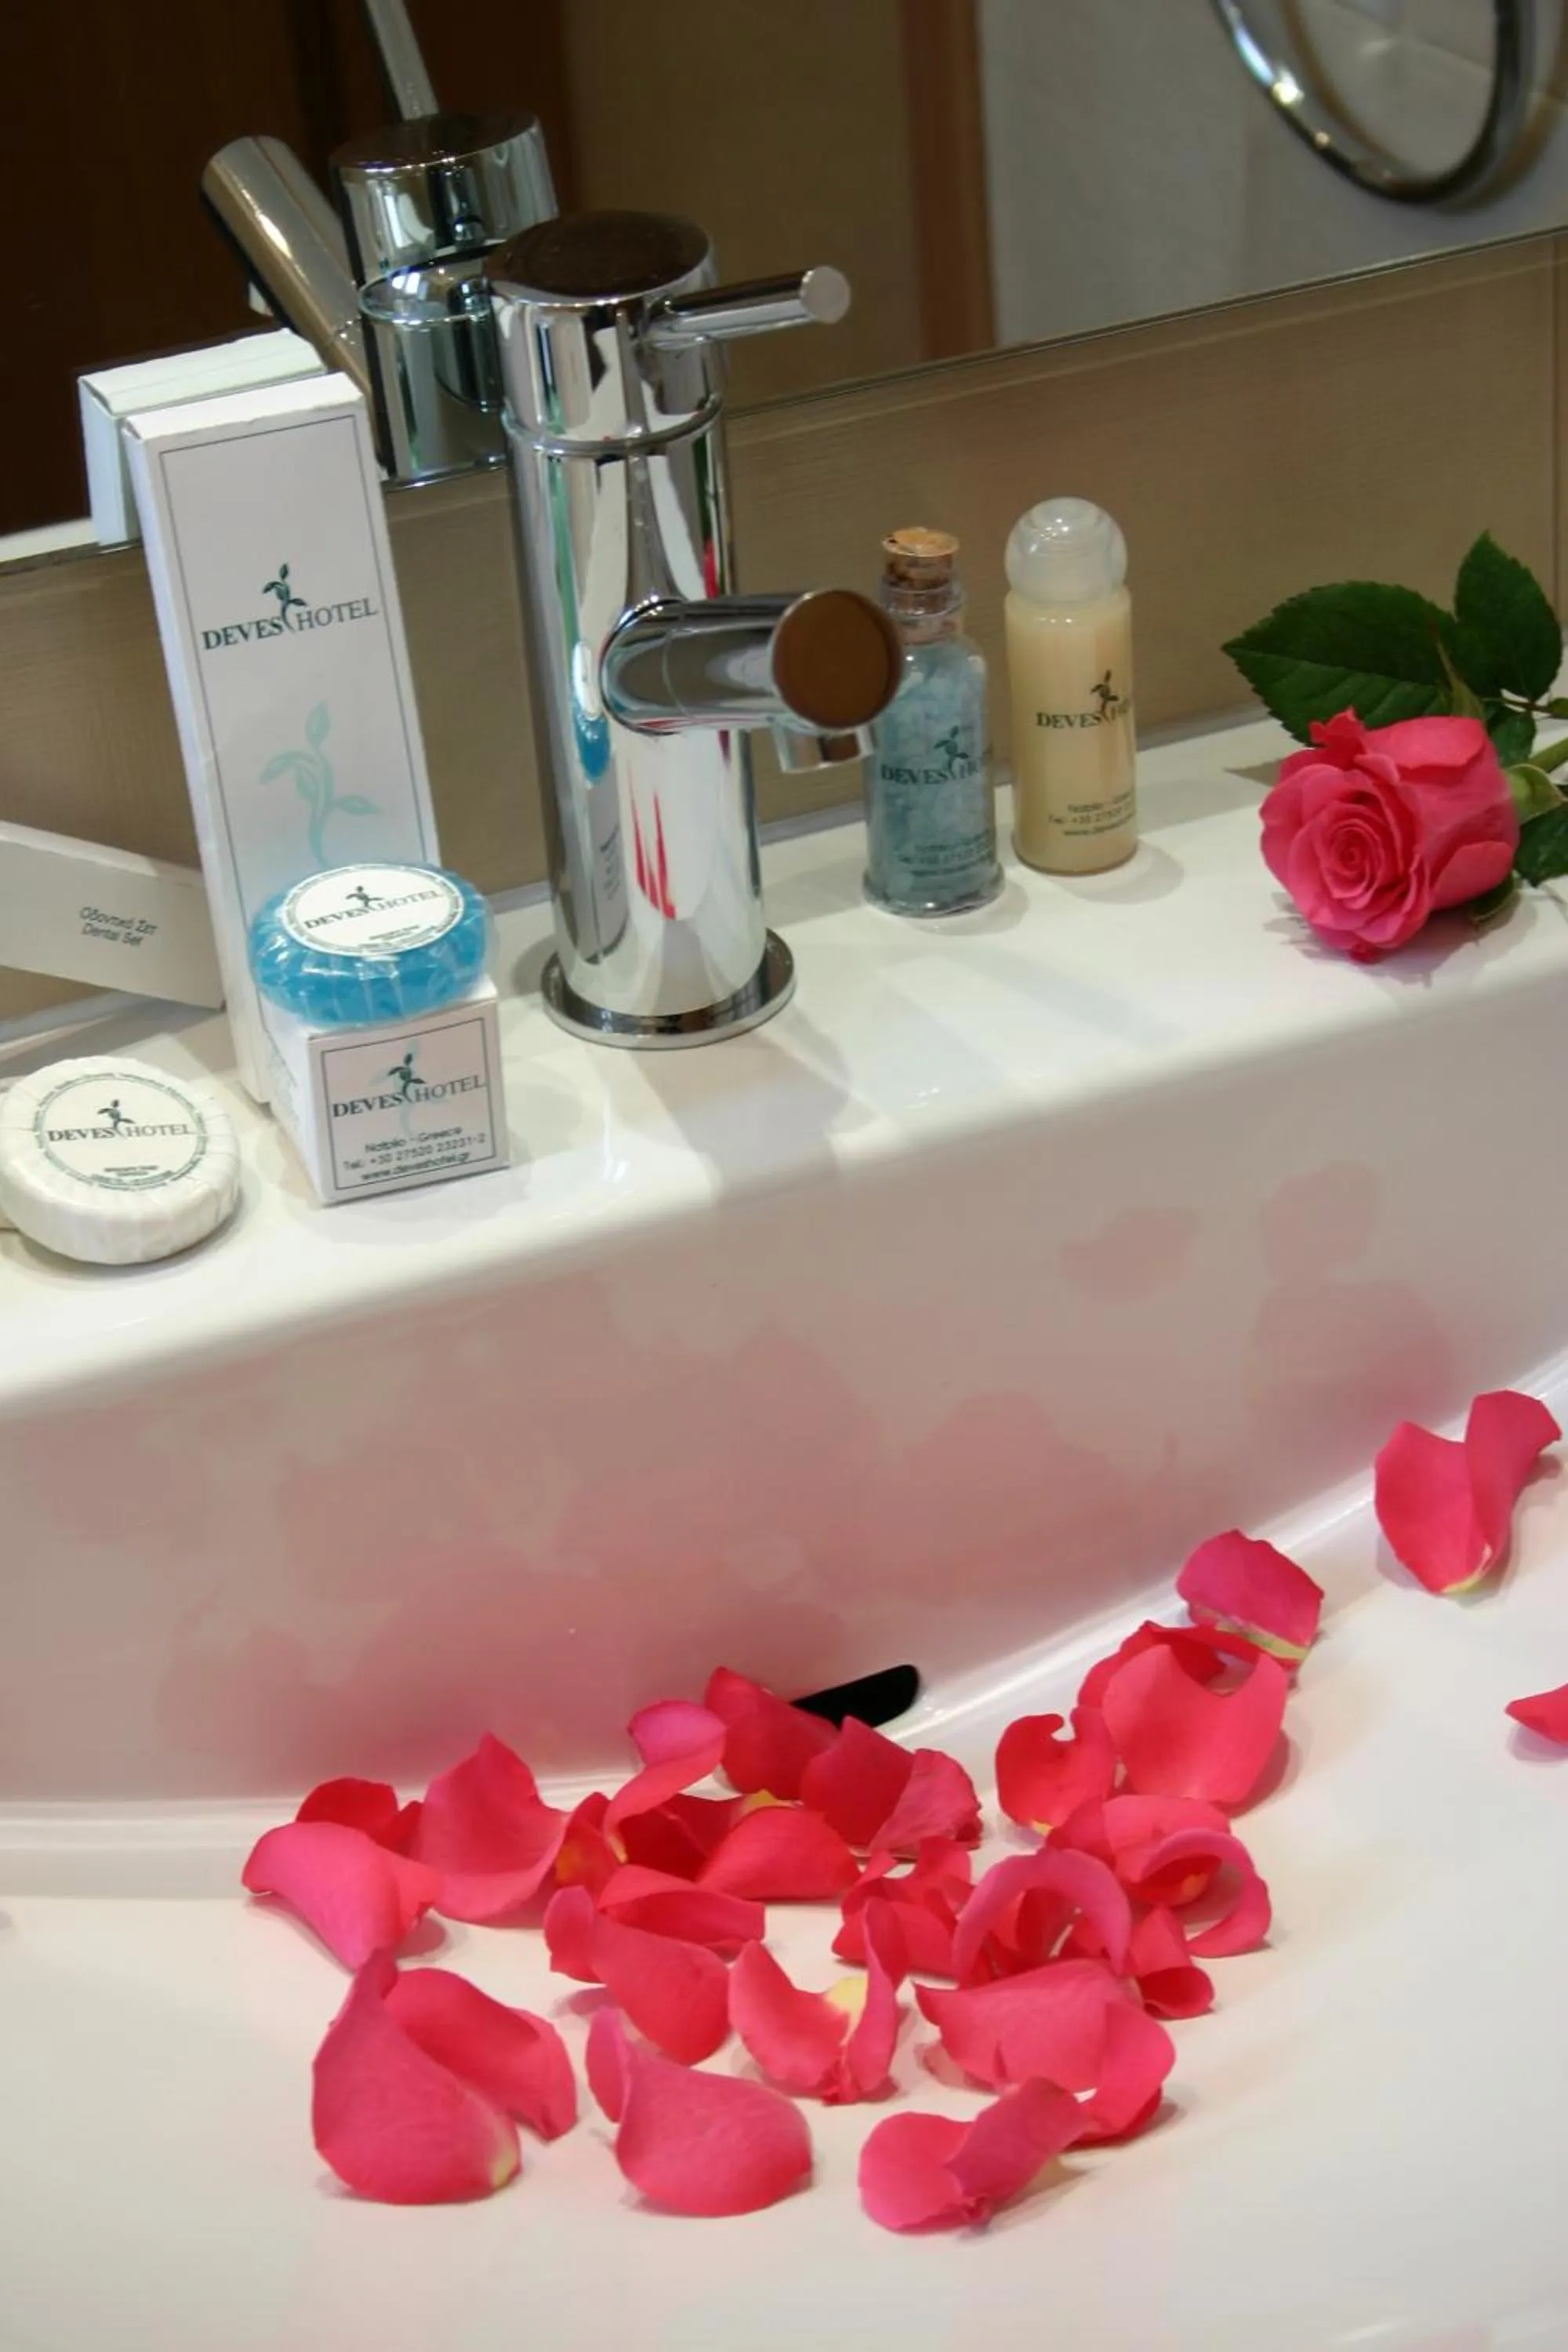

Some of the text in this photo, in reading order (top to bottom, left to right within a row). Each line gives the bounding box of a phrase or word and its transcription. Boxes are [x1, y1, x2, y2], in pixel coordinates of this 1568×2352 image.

[201, 597, 378, 650] DEVES HOTEL
[1035, 711, 1102, 729] DEVES
[303, 889, 445, 930] DEVES HOTEL
[82, 922, 120, 942] Dental
[332, 1075, 486, 1118] DEVES HOTEL
[47, 1123, 196, 1142] DEVES HOTEL
[418, 1127, 463, 1142] Greece
